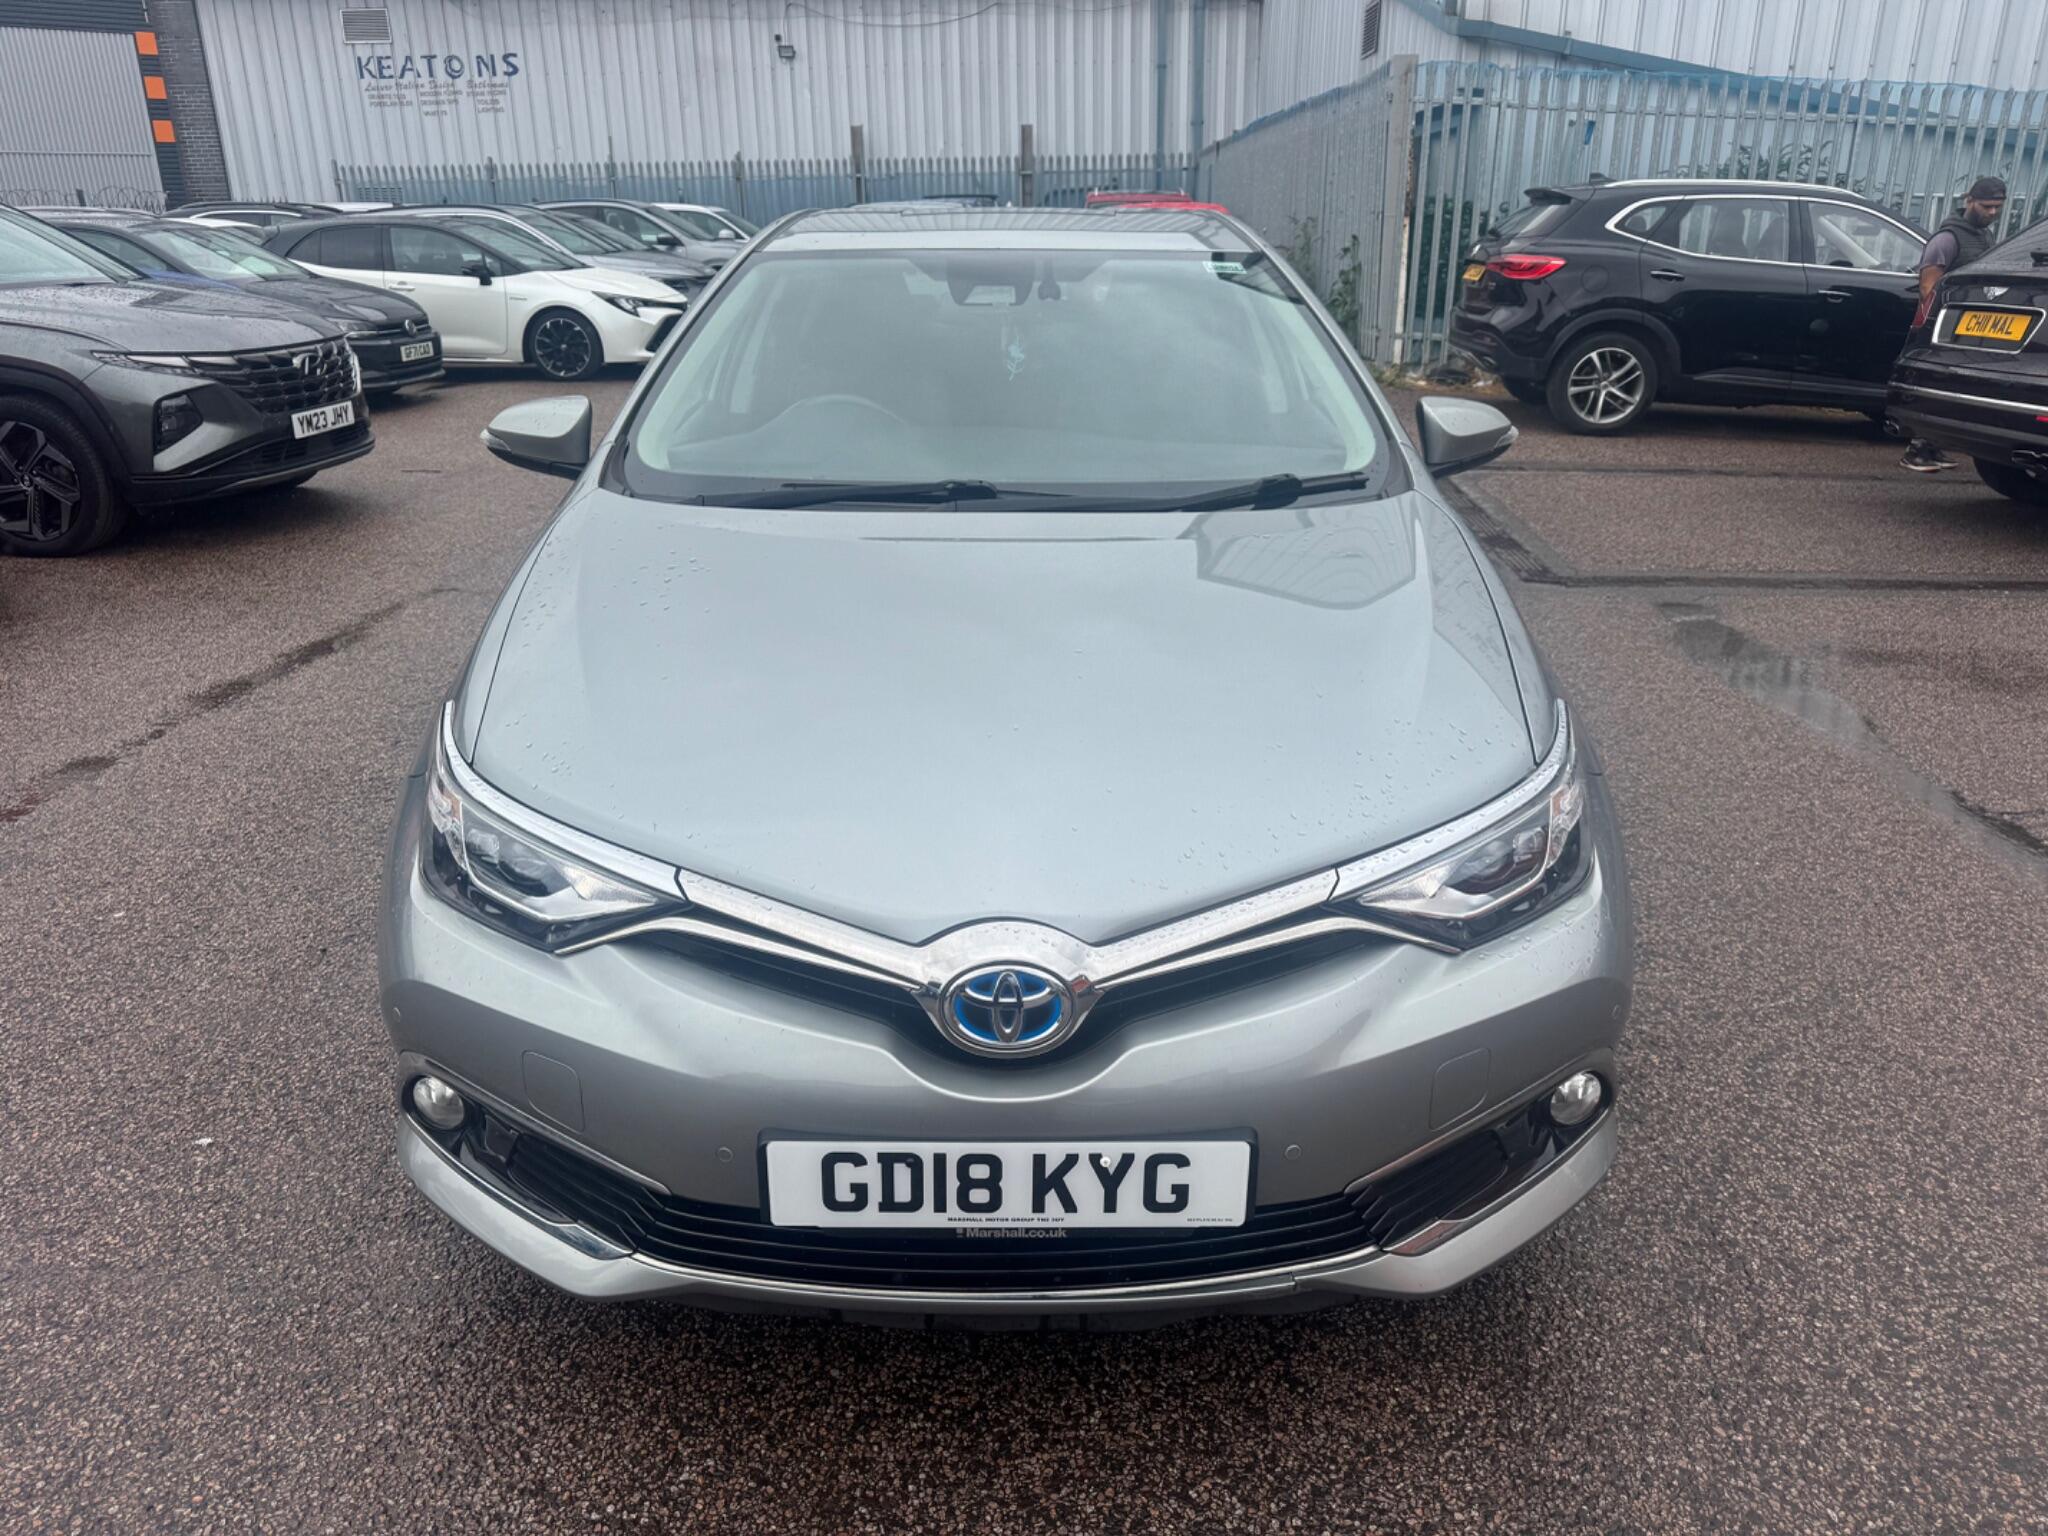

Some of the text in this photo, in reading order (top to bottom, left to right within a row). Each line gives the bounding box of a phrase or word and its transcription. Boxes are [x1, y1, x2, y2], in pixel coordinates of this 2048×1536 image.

[357, 53, 519, 79] KEATONS
[331, 404, 349, 426] JHY
[821, 1151, 1192, 1214] GD18 KYG
[966, 1227, 1067, 1239] Marshall.co.uk
